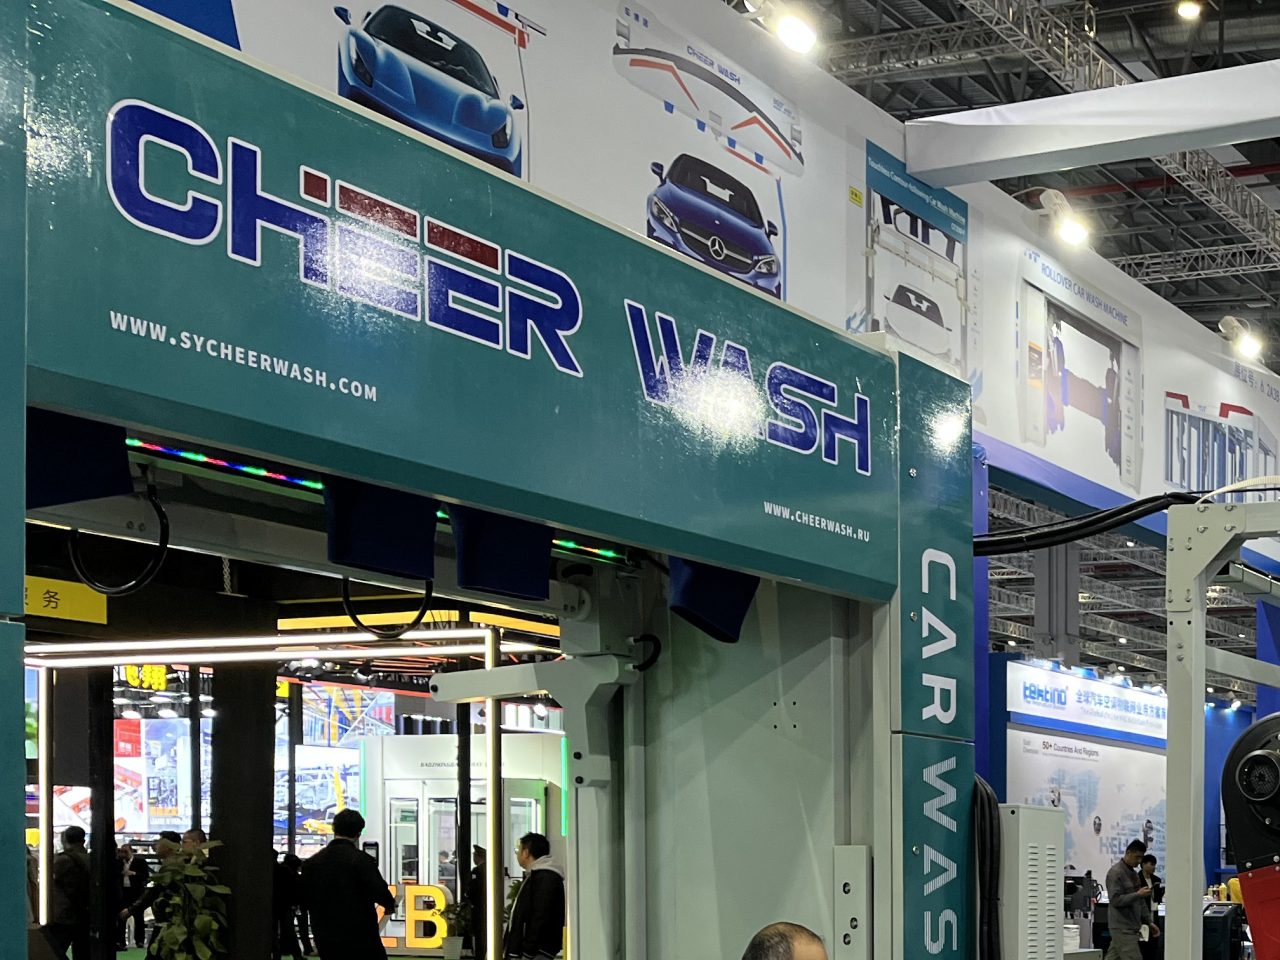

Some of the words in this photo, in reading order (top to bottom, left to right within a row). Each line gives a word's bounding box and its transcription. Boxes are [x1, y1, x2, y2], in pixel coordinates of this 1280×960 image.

[105, 98, 584, 377] CHEER
[624, 299, 872, 476] WASH
[1041, 263, 1074, 294] ROLLOVER
[1073, 284, 1086, 301] CAR
[110, 309, 378, 402] WWW.SYCHEERWASH.COM
[764, 500, 871, 543] WWW.CHEERWASH.RU
[921, 548, 957, 724] CAR
